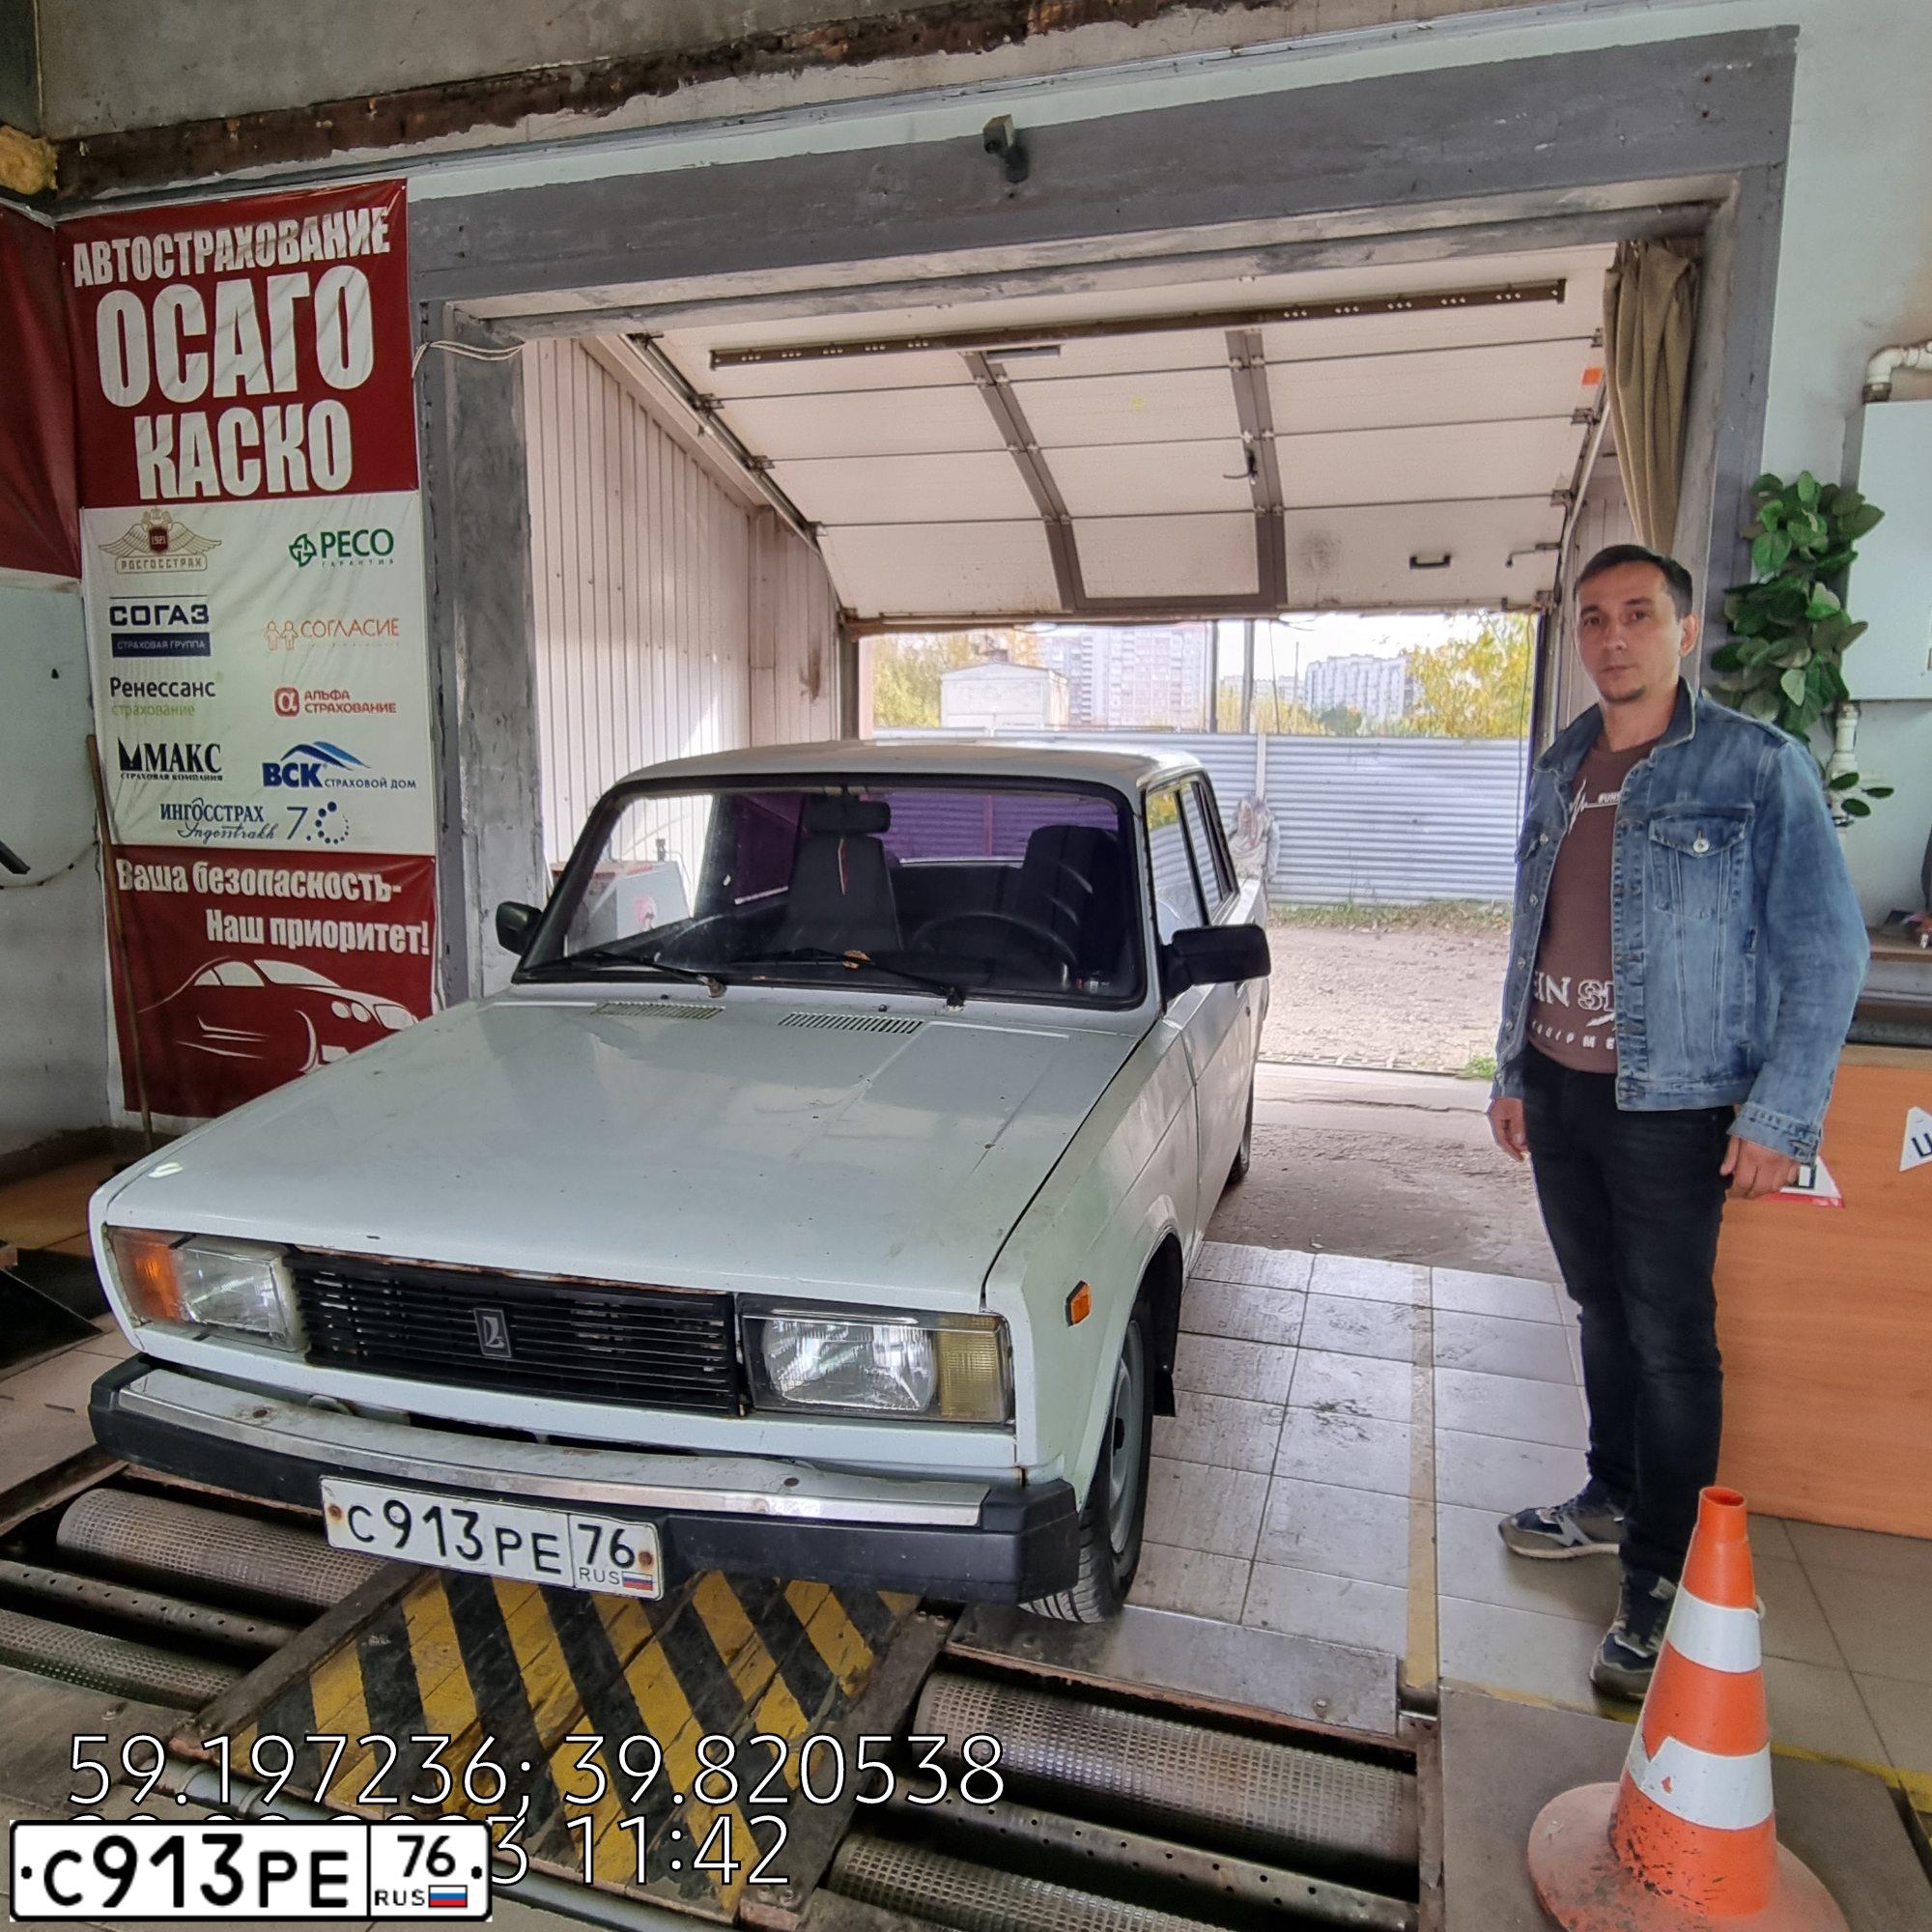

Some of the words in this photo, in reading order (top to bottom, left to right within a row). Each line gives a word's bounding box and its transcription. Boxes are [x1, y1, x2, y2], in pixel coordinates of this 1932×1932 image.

[73, 206, 391, 288] АВТОСТРАХОВАНИЕ
[97, 265, 375, 408] ОСАГО
[134, 398, 354, 500] КАСКО
[320, 527, 395, 559] РЕСО
[121, 557, 203, 571] РОСГОССТРАХ
[109, 604, 210, 627] СОГАЗ
[300, 618, 400, 639] СОГЛАСИЕ
[117, 639, 169, 651] СТРАХОВАЯ
[169, 639, 206, 650] ГРУППА
[109, 676, 216, 697] Ренессанс
[304, 689, 351, 701] АЛЬФА
[304, 702, 397, 714] СТРАХОВАНИЕ
[144, 742, 222, 774] МАКС
[262, 762, 324, 788] ВСК
[324, 777, 386, 789] СТРАХОВОЙ
[390, 780, 416, 789] ДОМ
[160, 797, 265, 822] ИНГОССТРАХ
[116, 859, 188, 894] Ваша
[206, 909, 264, 945] Наш
[270, 917, 431, 955] приоритет!
[347, 1499, 562, 1575] С913РЕ
[578, 1523, 636, 1569] 76
[579, 1567, 620, 1586] RUS
